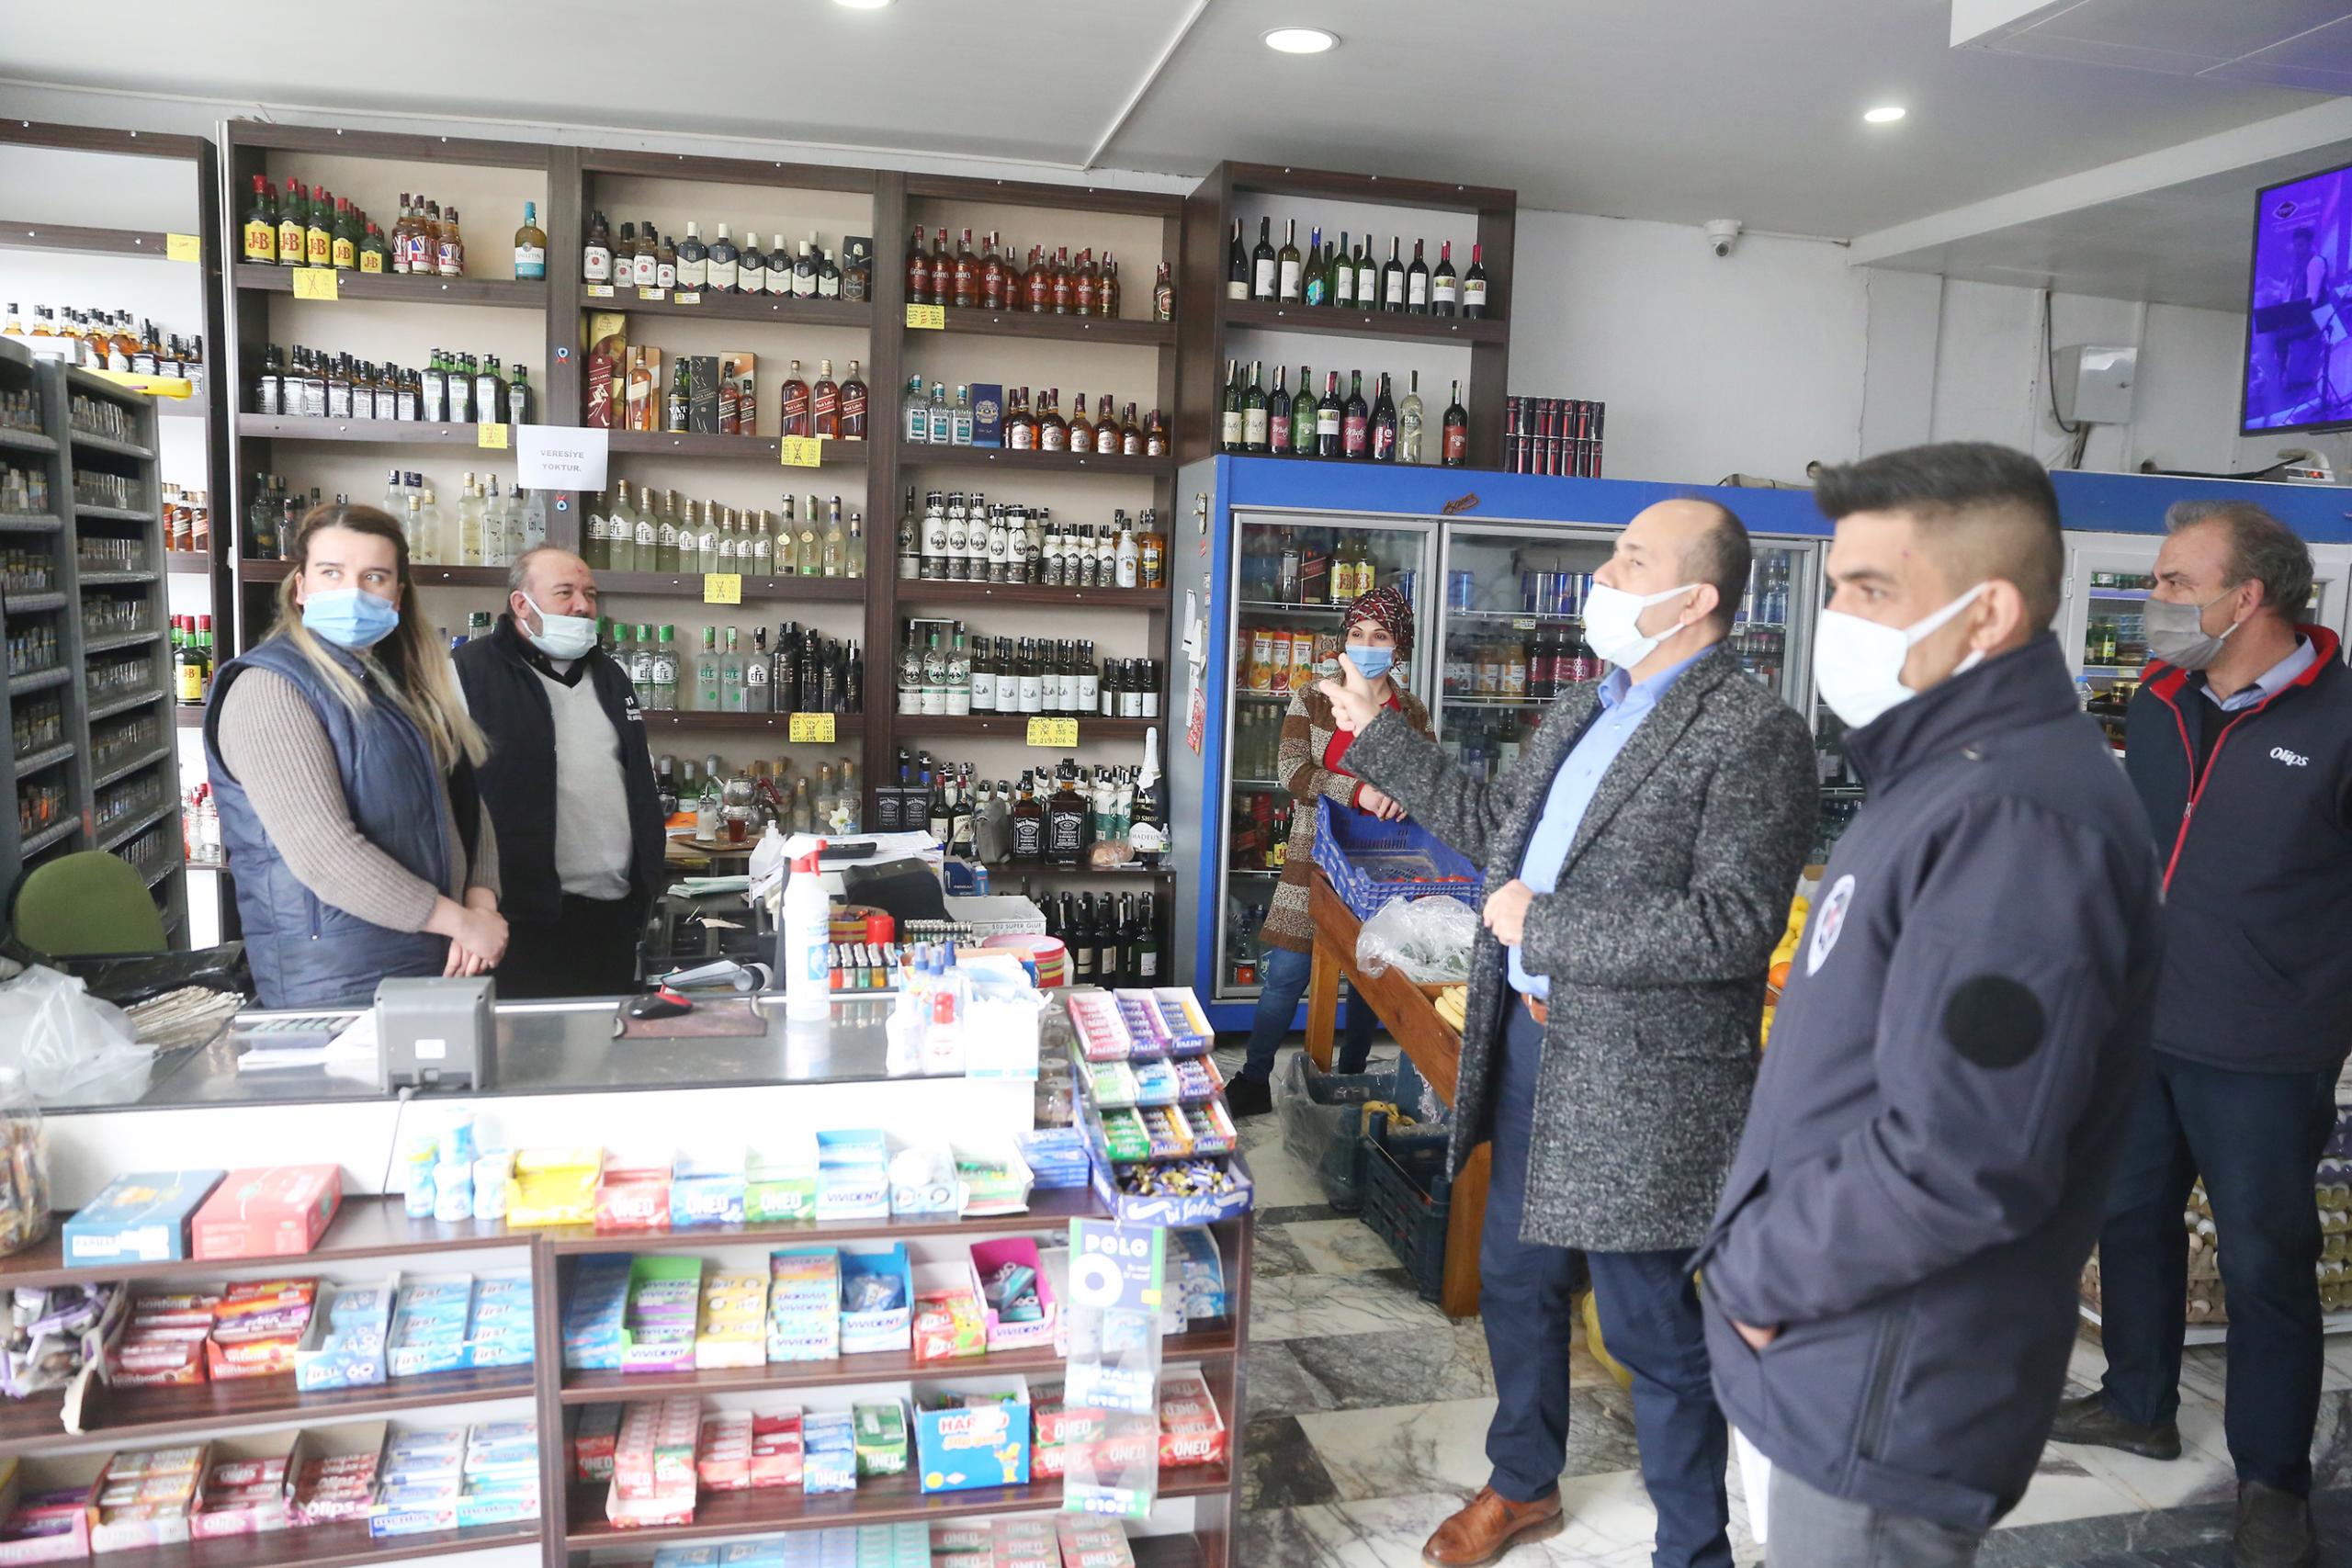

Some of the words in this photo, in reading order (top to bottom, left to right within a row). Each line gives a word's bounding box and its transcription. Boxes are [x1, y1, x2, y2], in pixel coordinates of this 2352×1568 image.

[249, 231, 269, 250] J&B
[280, 232, 300, 251] J&B
[309, 238, 326, 255] J&B
[336, 246, 351, 259] J&B
[365, 257, 379, 268] J&B
[669, 405, 688, 413] VAT
[540, 449, 584, 458] VERESİYE
[543, 463, 582, 472] YOKTUR.
[637, 527, 650, 541] EFE
[660, 528, 673, 542] EFE
[656, 668, 669, 679] EFE
[701, 666, 714, 678] EFE
[1320, 663, 1339, 672] Tropica
[752, 671, 763, 682] EFE
[2270, 747, 2309, 766] Olips
[1054, 816, 1064, 824] JACK
[1064, 813, 1081, 824] DANIEL'S
[1177, 1039, 1202, 1049] FALIM
[1185, 1086, 1210, 1096] FALIM
[827, 1190, 878, 1203] VIVIDENT
[1085, 1234, 1148, 1258] POLO
[408, 1288, 442, 1300] First
[480, 1283, 512, 1295] First
[476, 1304, 509, 1316] First
[405, 1317, 436, 1328] First
[847, 1317, 900, 1328] VIVIDENT
[474, 1327, 506, 1339] First
[997, 1325, 1045, 1336] VIVIDENT
[777, 1337, 829, 1346] VIVIDENT
[472, 1348, 503, 1359] First
[631, 1348, 684, 1358] VIVIDENT
[395, 1355, 424, 1366] First
[305, 1369, 336, 1380] First
[346, 1362, 375, 1380] 60
[942, 1415, 1008, 1432] HAR
[1055, 1420, 1091, 1439] ONEO
[1110, 1445, 1146, 1461] ONEO
[1173, 1440, 1211, 1456] ONEO
[580, 1456, 613, 1470] ONEO
[866, 1453, 899, 1469] ONEO
[815, 1470, 849, 1485] ONEO
[306, 1501, 356, 1517] Olips
[944, 1532, 979, 1544] ONEO
[1076, 1533, 1111, 1546] ONEO
[1009, 1542, 1044, 1553] ONEO
[945, 1555, 980, 1567] ONEO
[1081, 1552, 1116, 1567] ONEO
